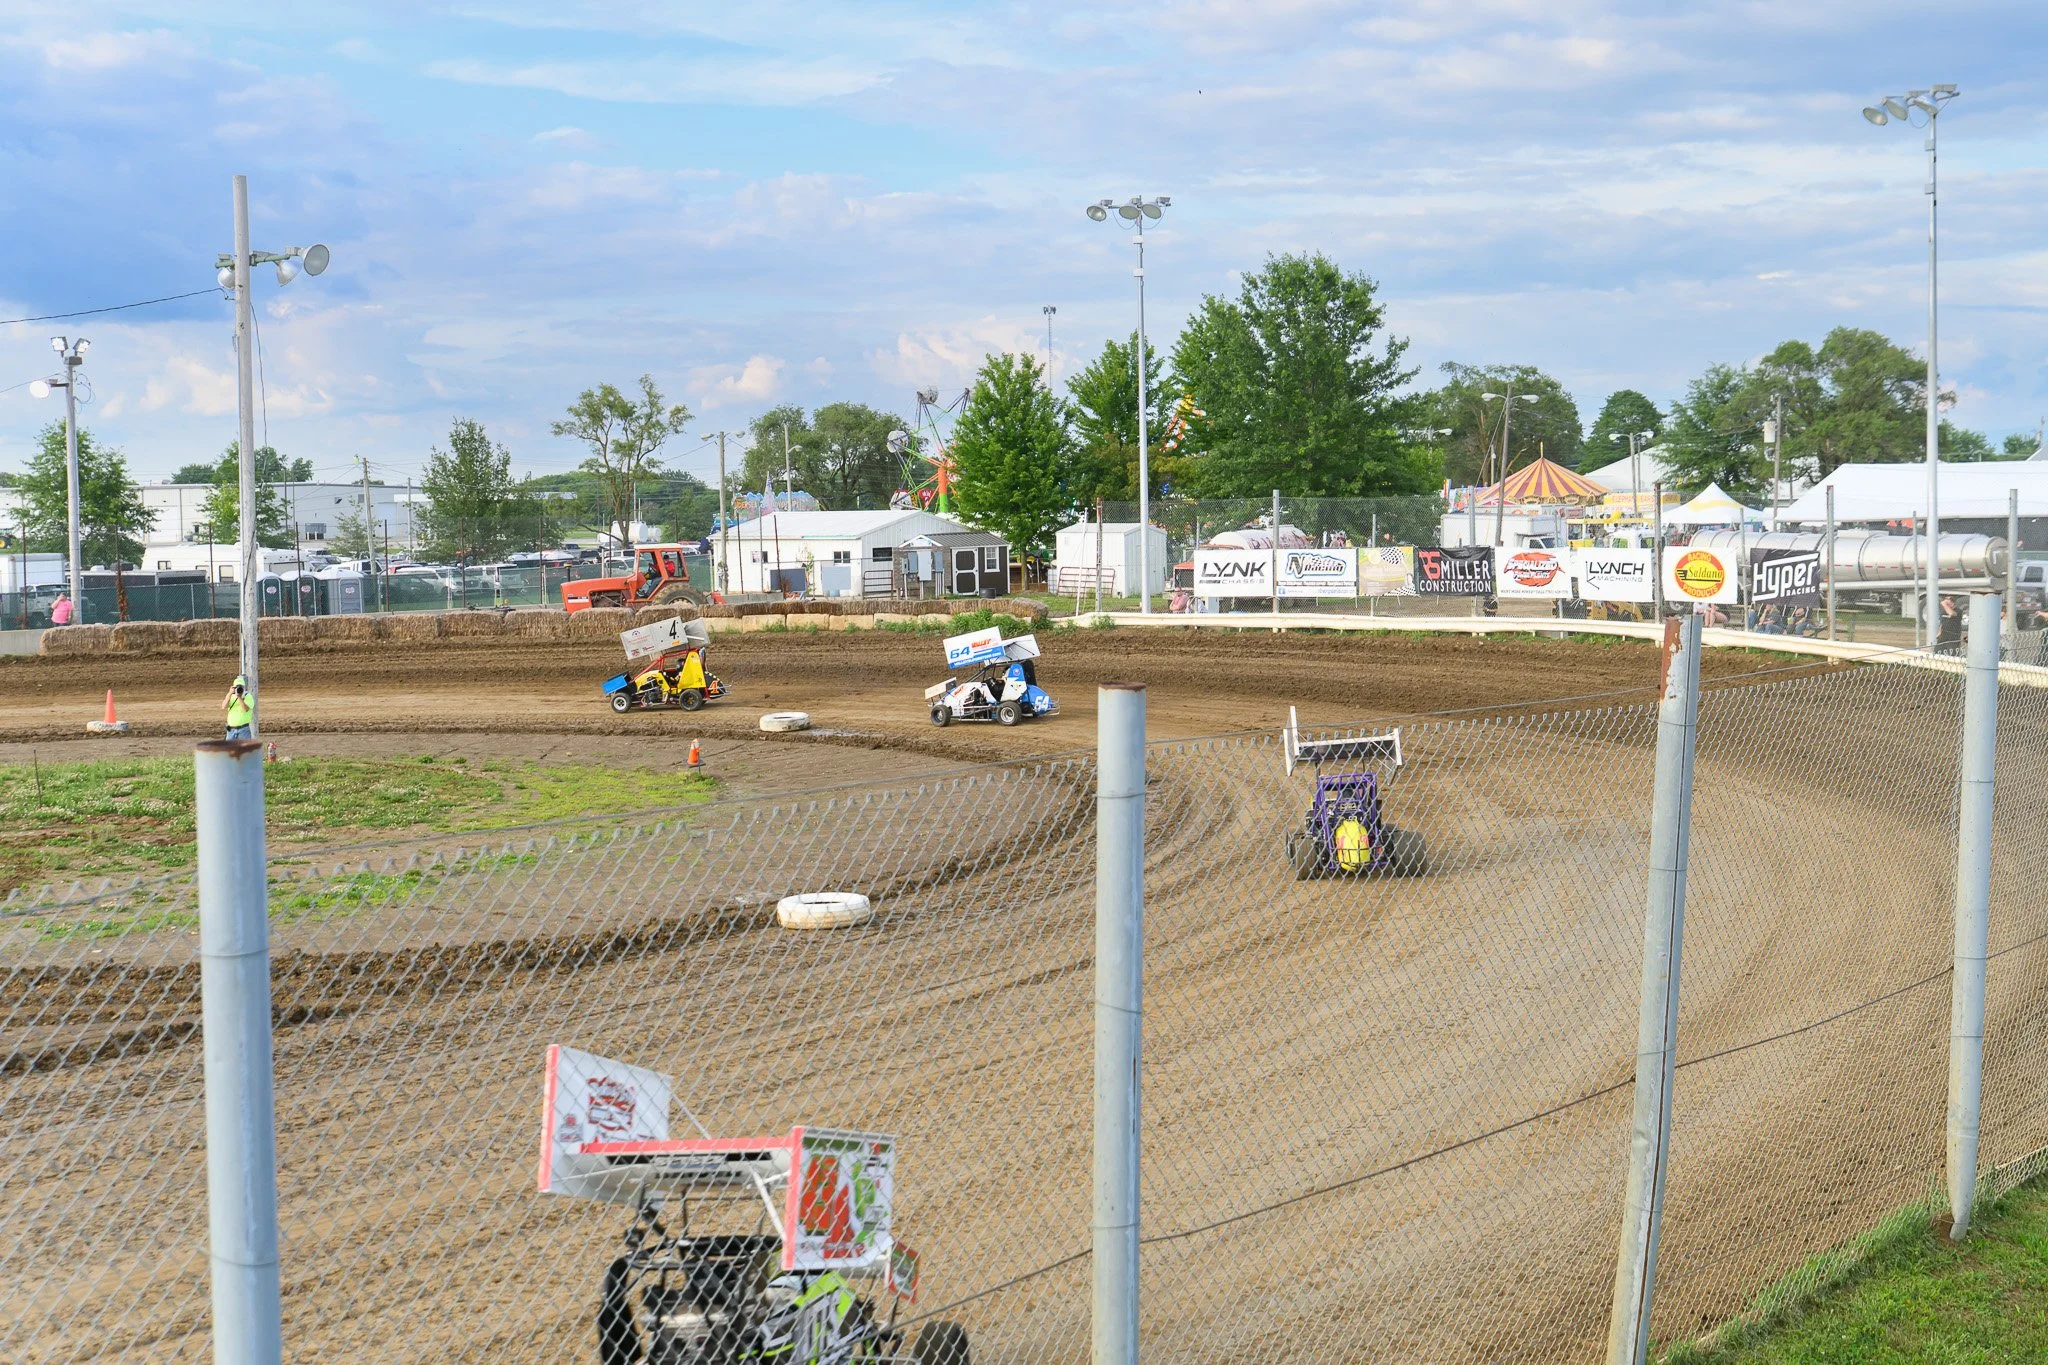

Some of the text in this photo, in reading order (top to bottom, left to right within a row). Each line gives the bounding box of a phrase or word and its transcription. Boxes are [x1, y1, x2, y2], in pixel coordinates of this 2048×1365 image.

[1688, 553, 1711, 561] RACING
[1201, 562, 1266, 577] LYNK
[1440, 561, 1490, 580] MILLER
[1589, 562, 1644, 575] LYNCH
[1752, 553, 1819, 601] Hyper
[1420, 580, 1491, 592] CONSTRUCTION
[1683, 584, 1718, 597] PRODUCTS
[1786, 586, 1816, 597] RACING
[669, 619, 677, 640] 4
[950, 646, 970, 659] 64
[709, 681, 720, 694] 4
[1034, 695, 1050, 711] 64
